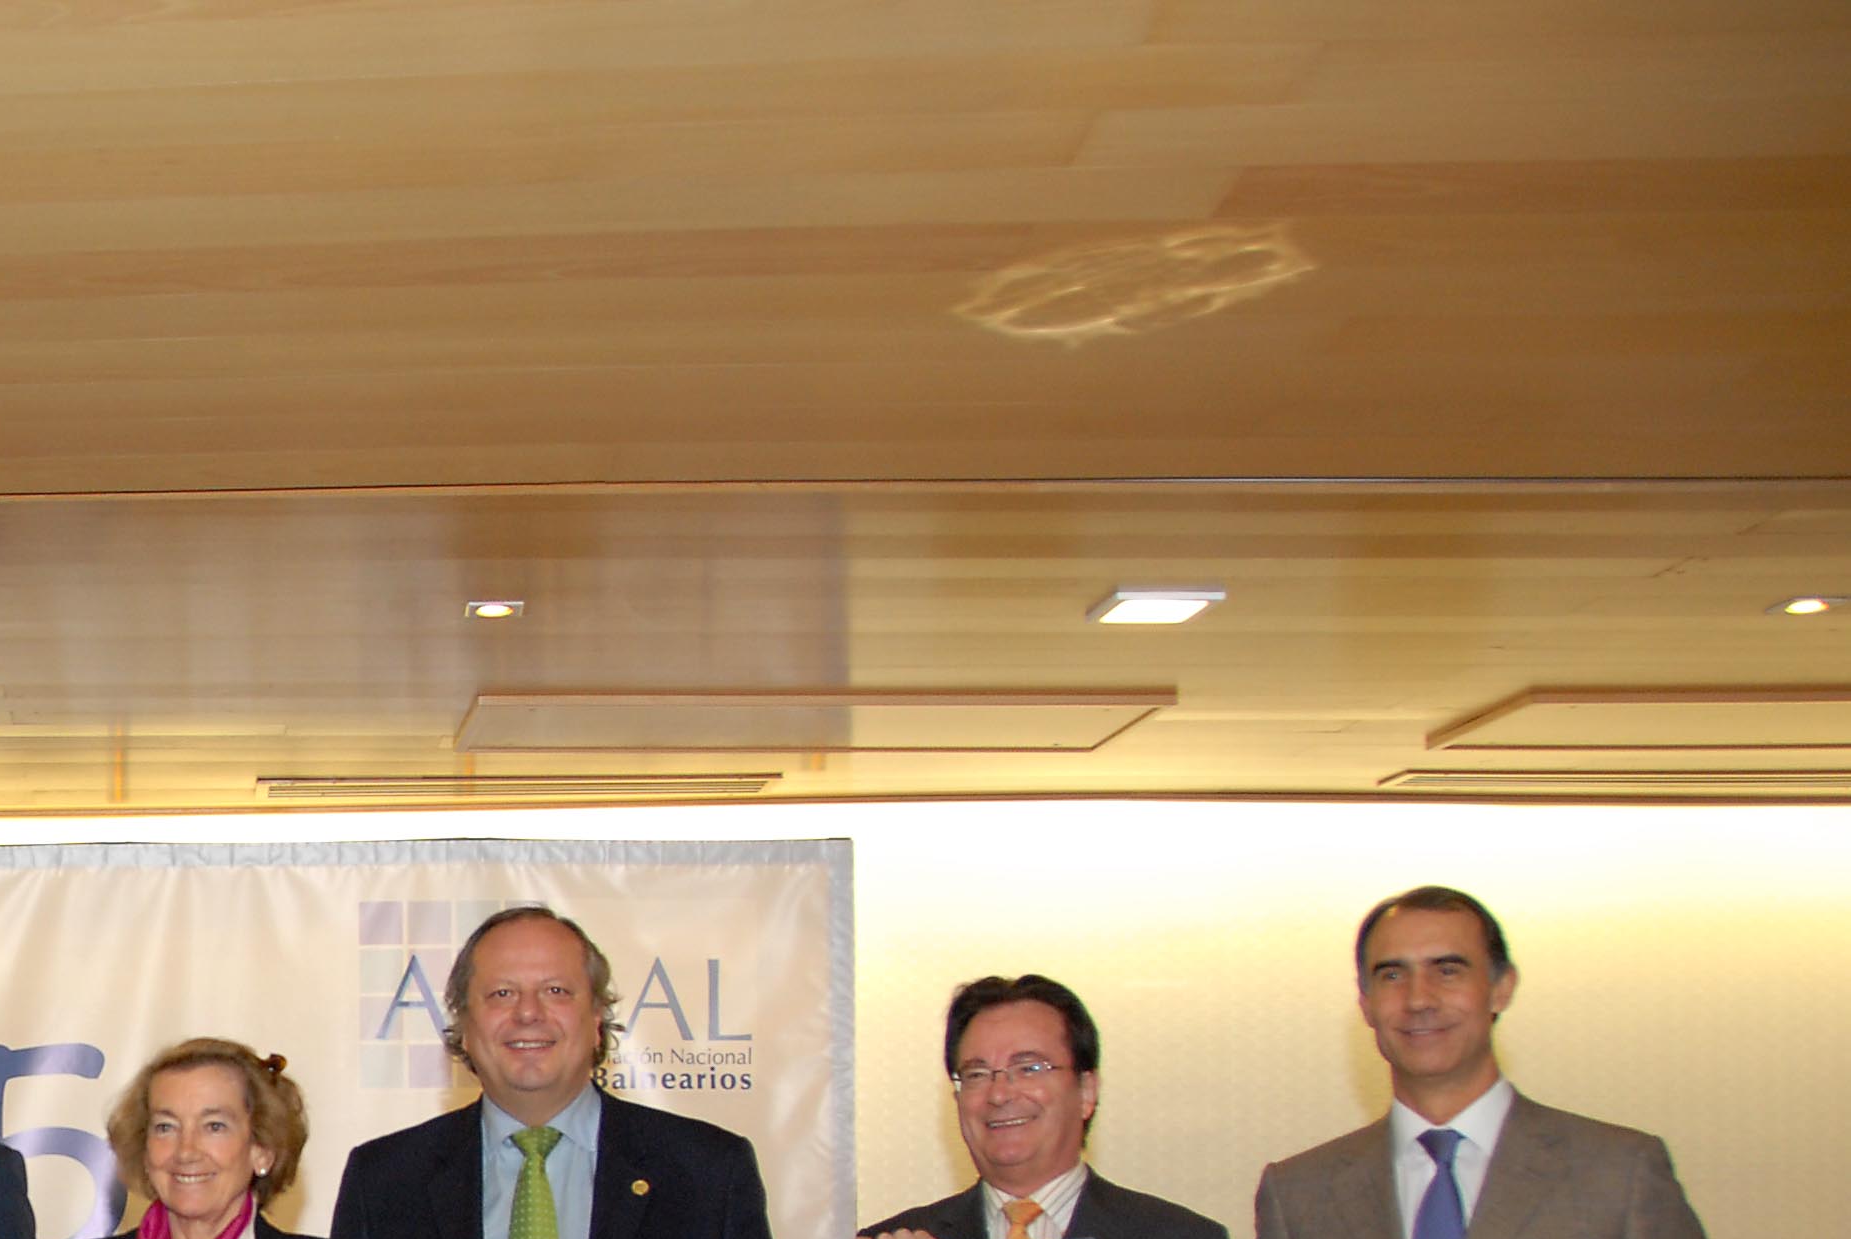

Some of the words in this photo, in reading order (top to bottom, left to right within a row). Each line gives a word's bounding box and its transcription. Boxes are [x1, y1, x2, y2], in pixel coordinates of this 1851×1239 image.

[375, 954, 752, 1041] AAL
[670, 1047, 752, 1065] Nacional
[594, 1066, 752, 1090] Balnearios
